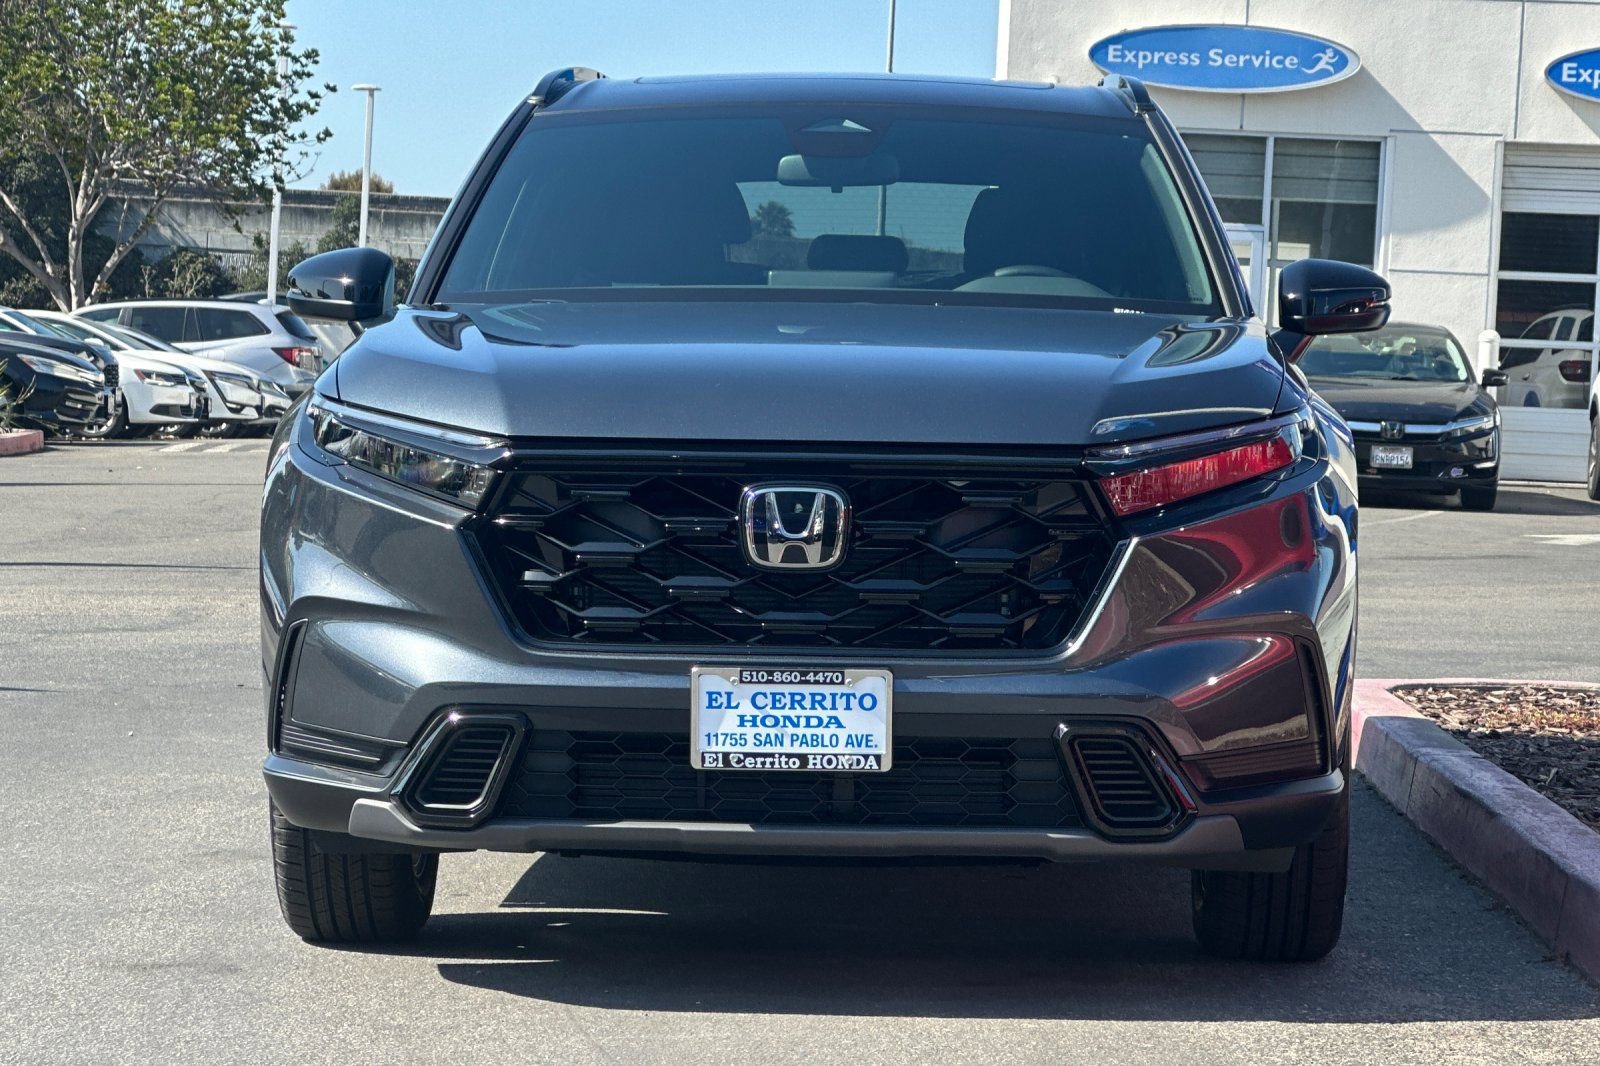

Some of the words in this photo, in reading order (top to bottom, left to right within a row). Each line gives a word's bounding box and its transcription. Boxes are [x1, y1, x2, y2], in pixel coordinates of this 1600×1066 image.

[1107, 44, 1201, 69] Express
[1207, 48, 1299, 69] Service
[741, 671, 843, 684] 510-860-4470
[705, 691, 741, 710] EL
[750, 692, 878, 711] CERRITO
[736, 714, 846, 729] HONDA
[704, 732, 748, 747] 11755
[753, 733, 784, 748] SAN
[790, 733, 839, 748] PABLO
[845, 734, 879, 749] AVE.
[703, 753, 724, 768] El
[730, 753, 800, 769] Cerrito
[807, 755, 879, 770] HONDA
